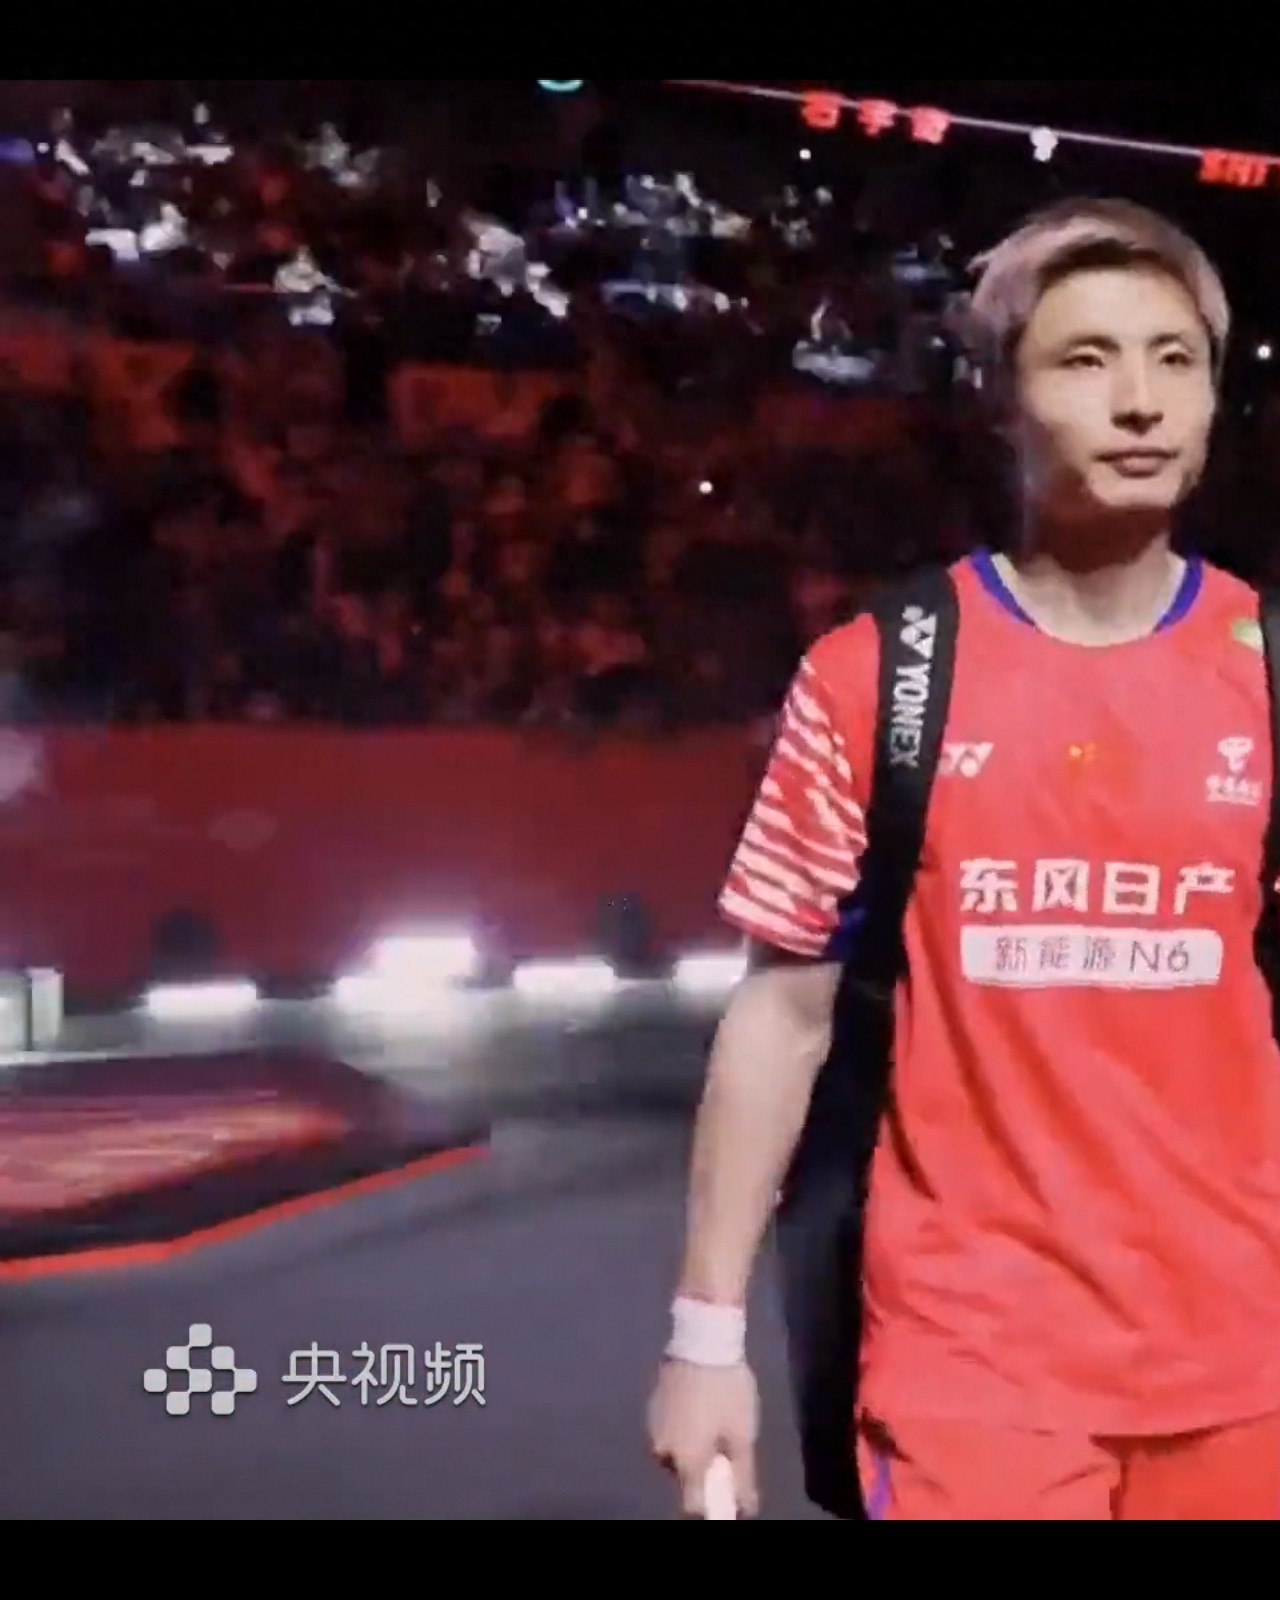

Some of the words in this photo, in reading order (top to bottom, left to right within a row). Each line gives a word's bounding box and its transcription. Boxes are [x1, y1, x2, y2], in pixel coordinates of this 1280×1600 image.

[890, 662, 931, 768] YONEX
[959, 858, 1236, 915] 东风日产
